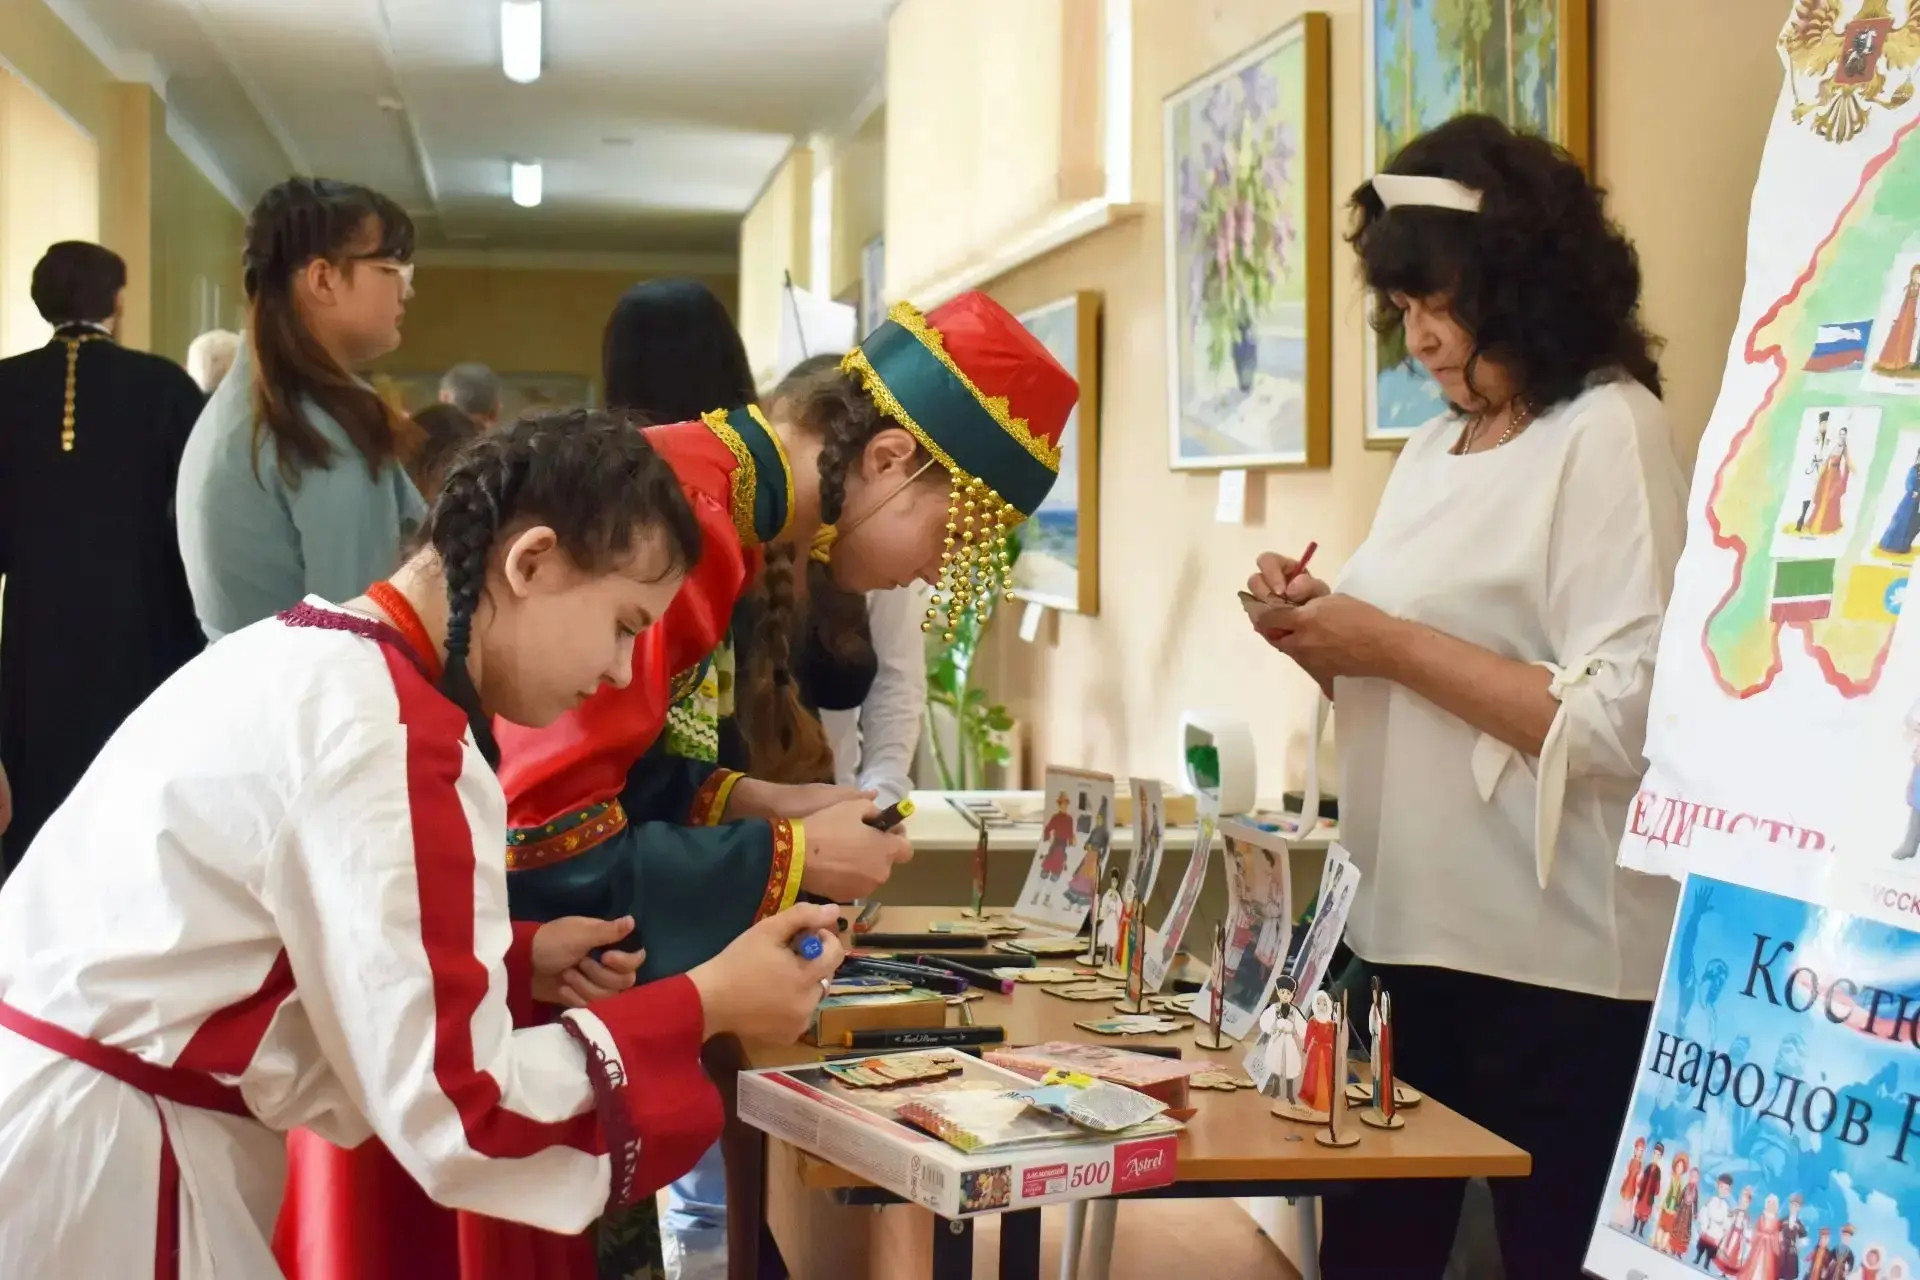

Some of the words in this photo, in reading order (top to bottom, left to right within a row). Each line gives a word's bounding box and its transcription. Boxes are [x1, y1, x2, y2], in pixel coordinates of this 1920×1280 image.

[1649, 1030, 1873, 1146] народов
[1070, 1160, 1110, 1188] 500
[1123, 1148, 1164, 1179] Astrel
